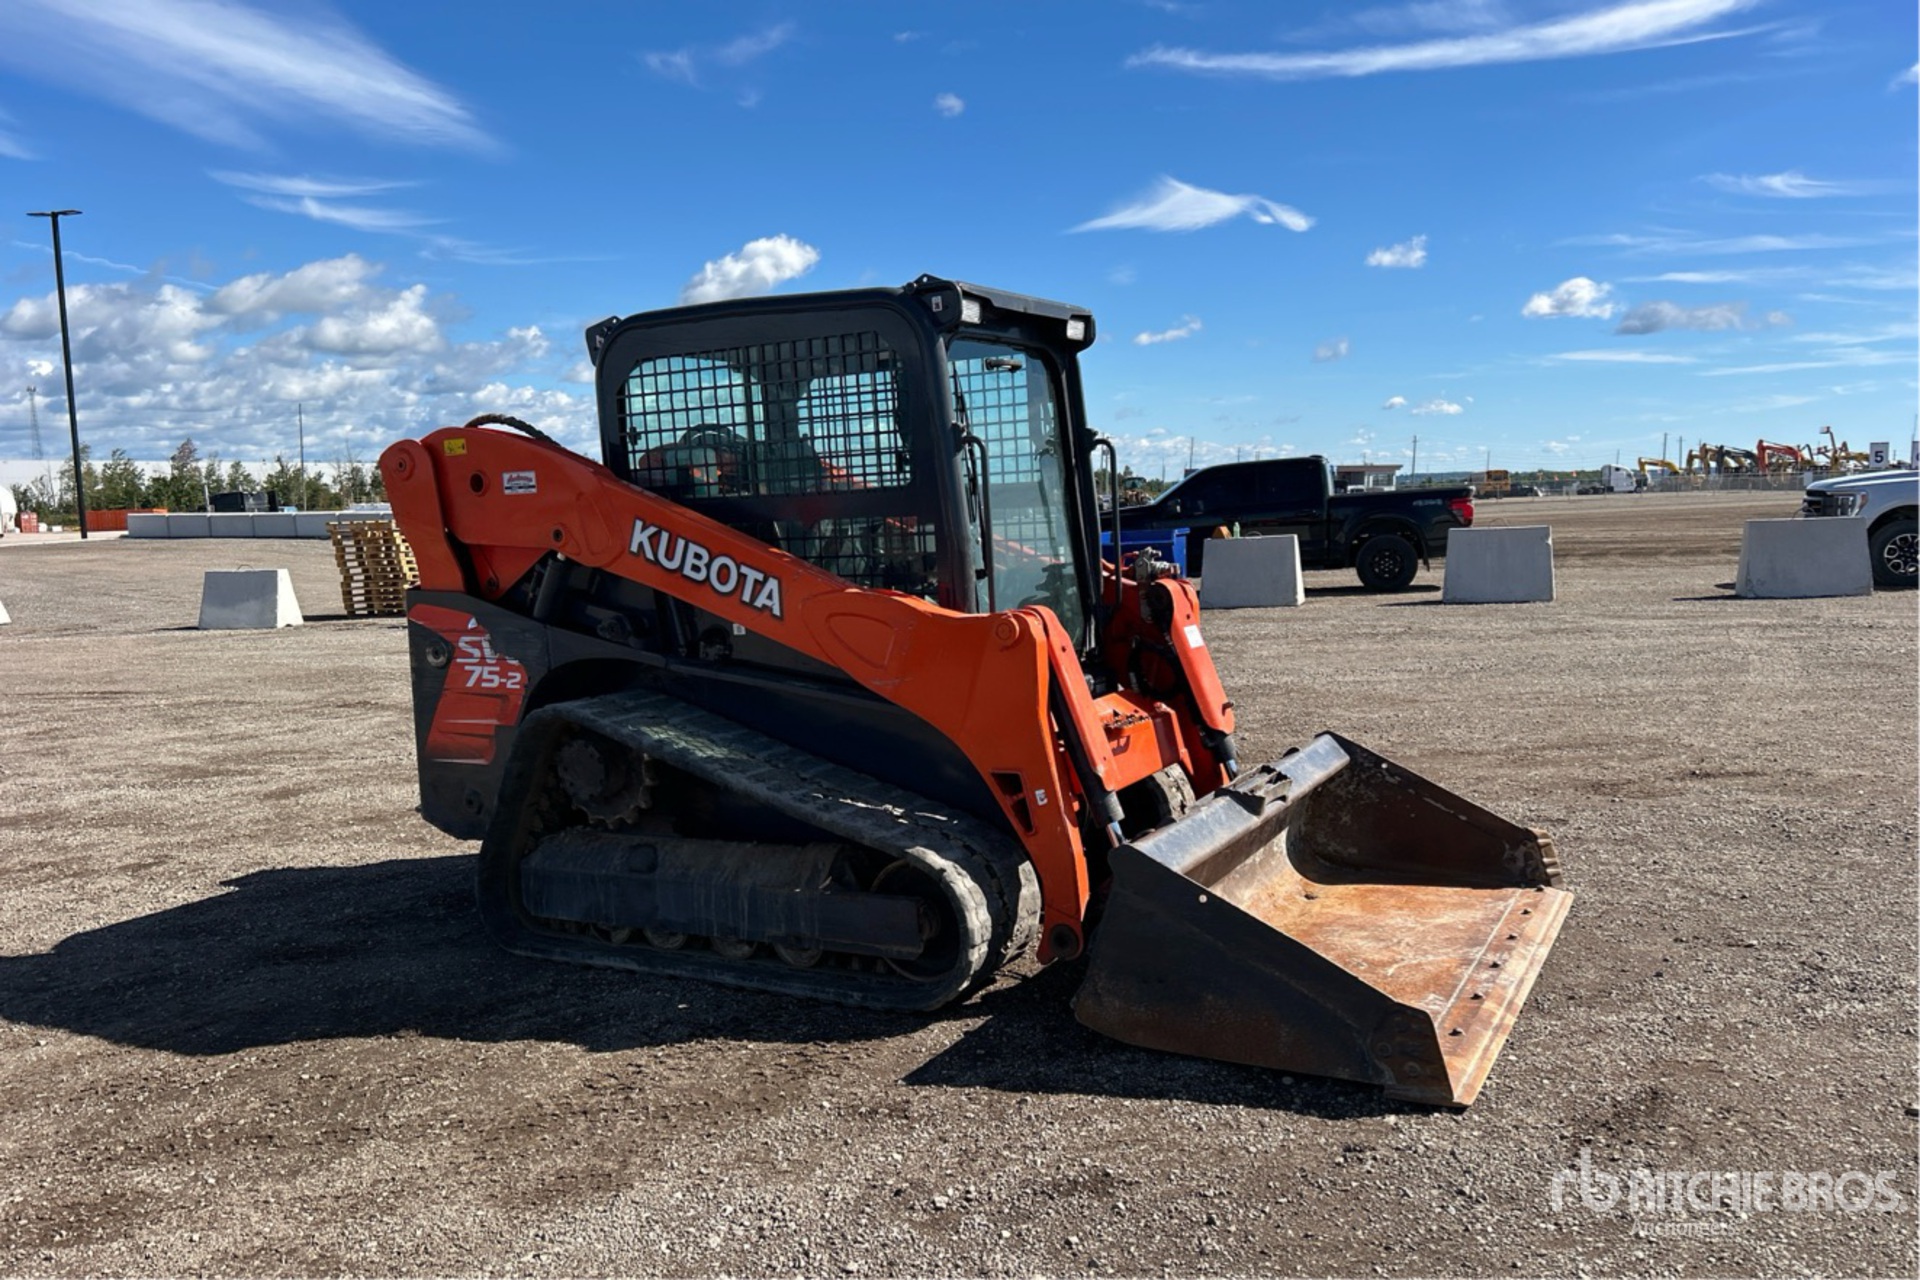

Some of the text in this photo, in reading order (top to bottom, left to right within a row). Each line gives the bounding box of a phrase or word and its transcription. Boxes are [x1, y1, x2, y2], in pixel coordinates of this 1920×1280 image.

[1874, 450, 1884, 463] 5
[629, 518, 782, 617] KUBOTA
[464, 665, 522, 689] 75-2
